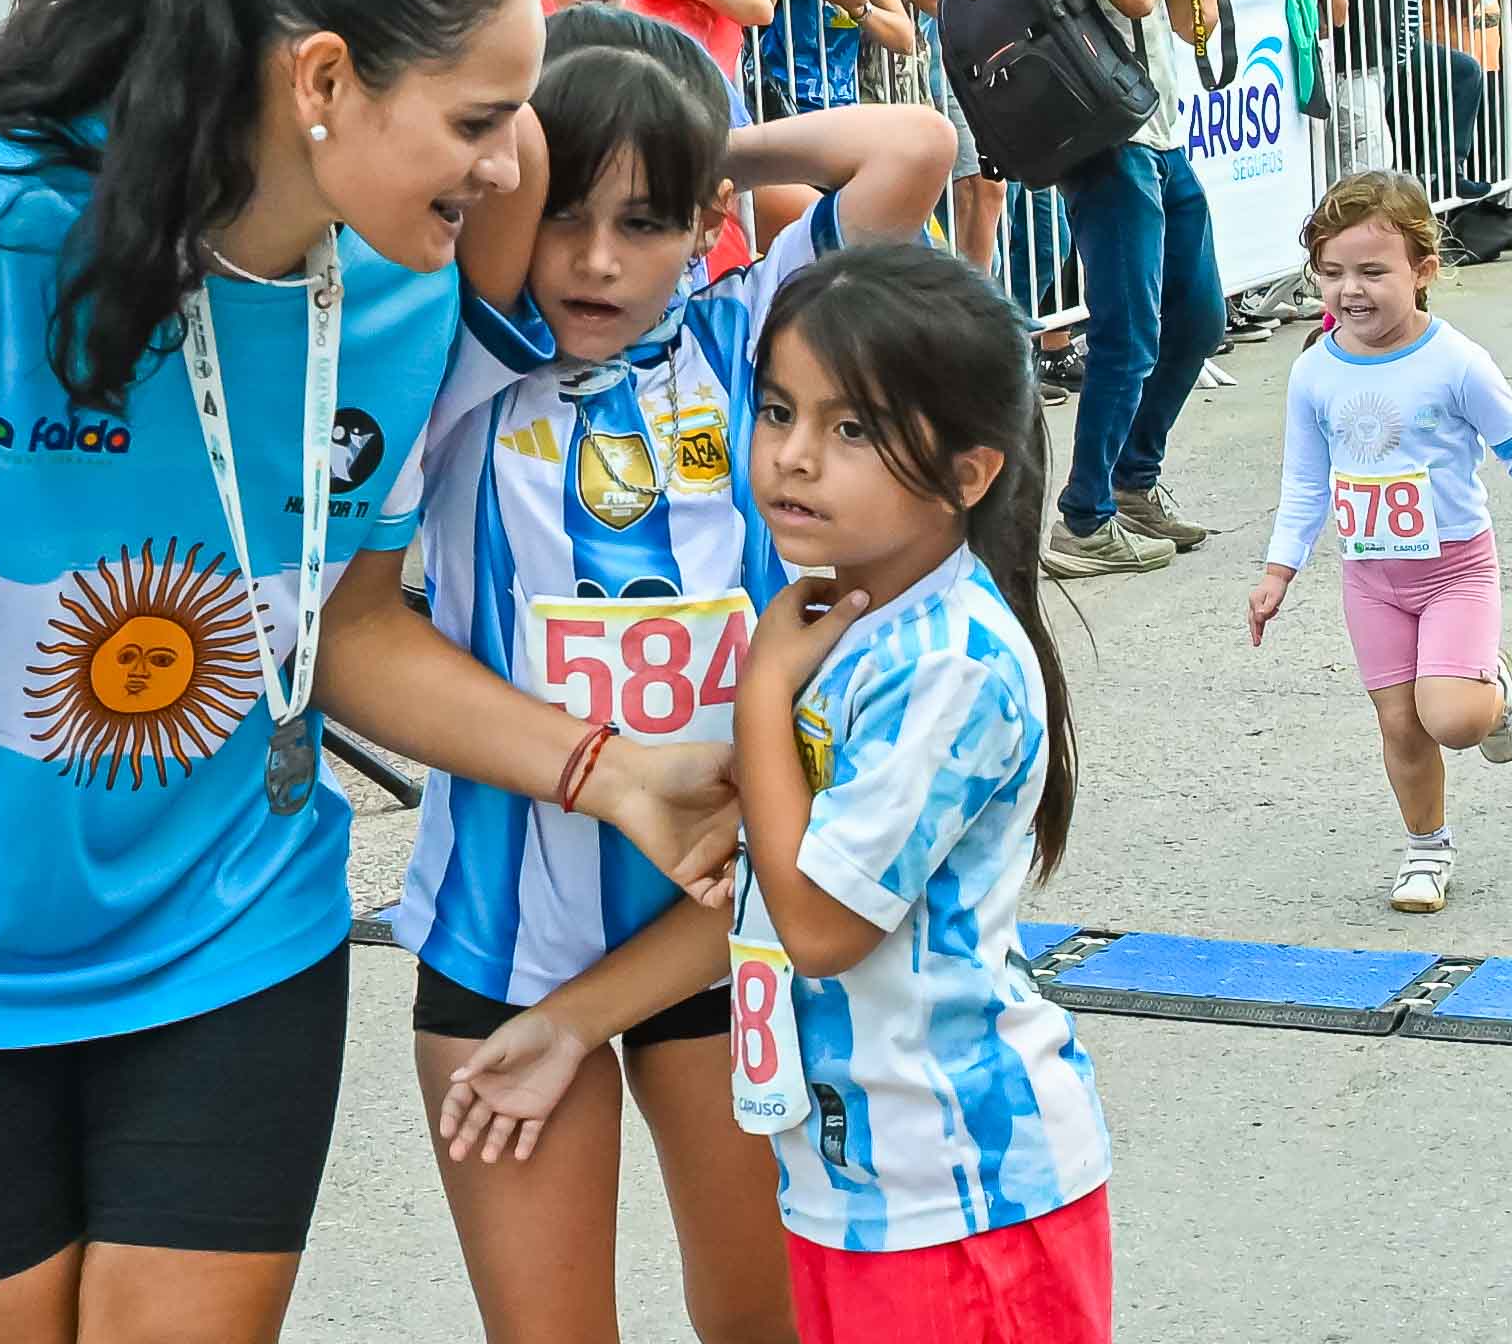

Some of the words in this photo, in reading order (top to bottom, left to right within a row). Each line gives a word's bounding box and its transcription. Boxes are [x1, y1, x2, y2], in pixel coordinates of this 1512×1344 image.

[1177, 82, 1281, 162] ARUSO
[29, 416, 131, 454] falda
[1334, 479, 1425, 538] 578
[545, 610, 751, 735] 584
